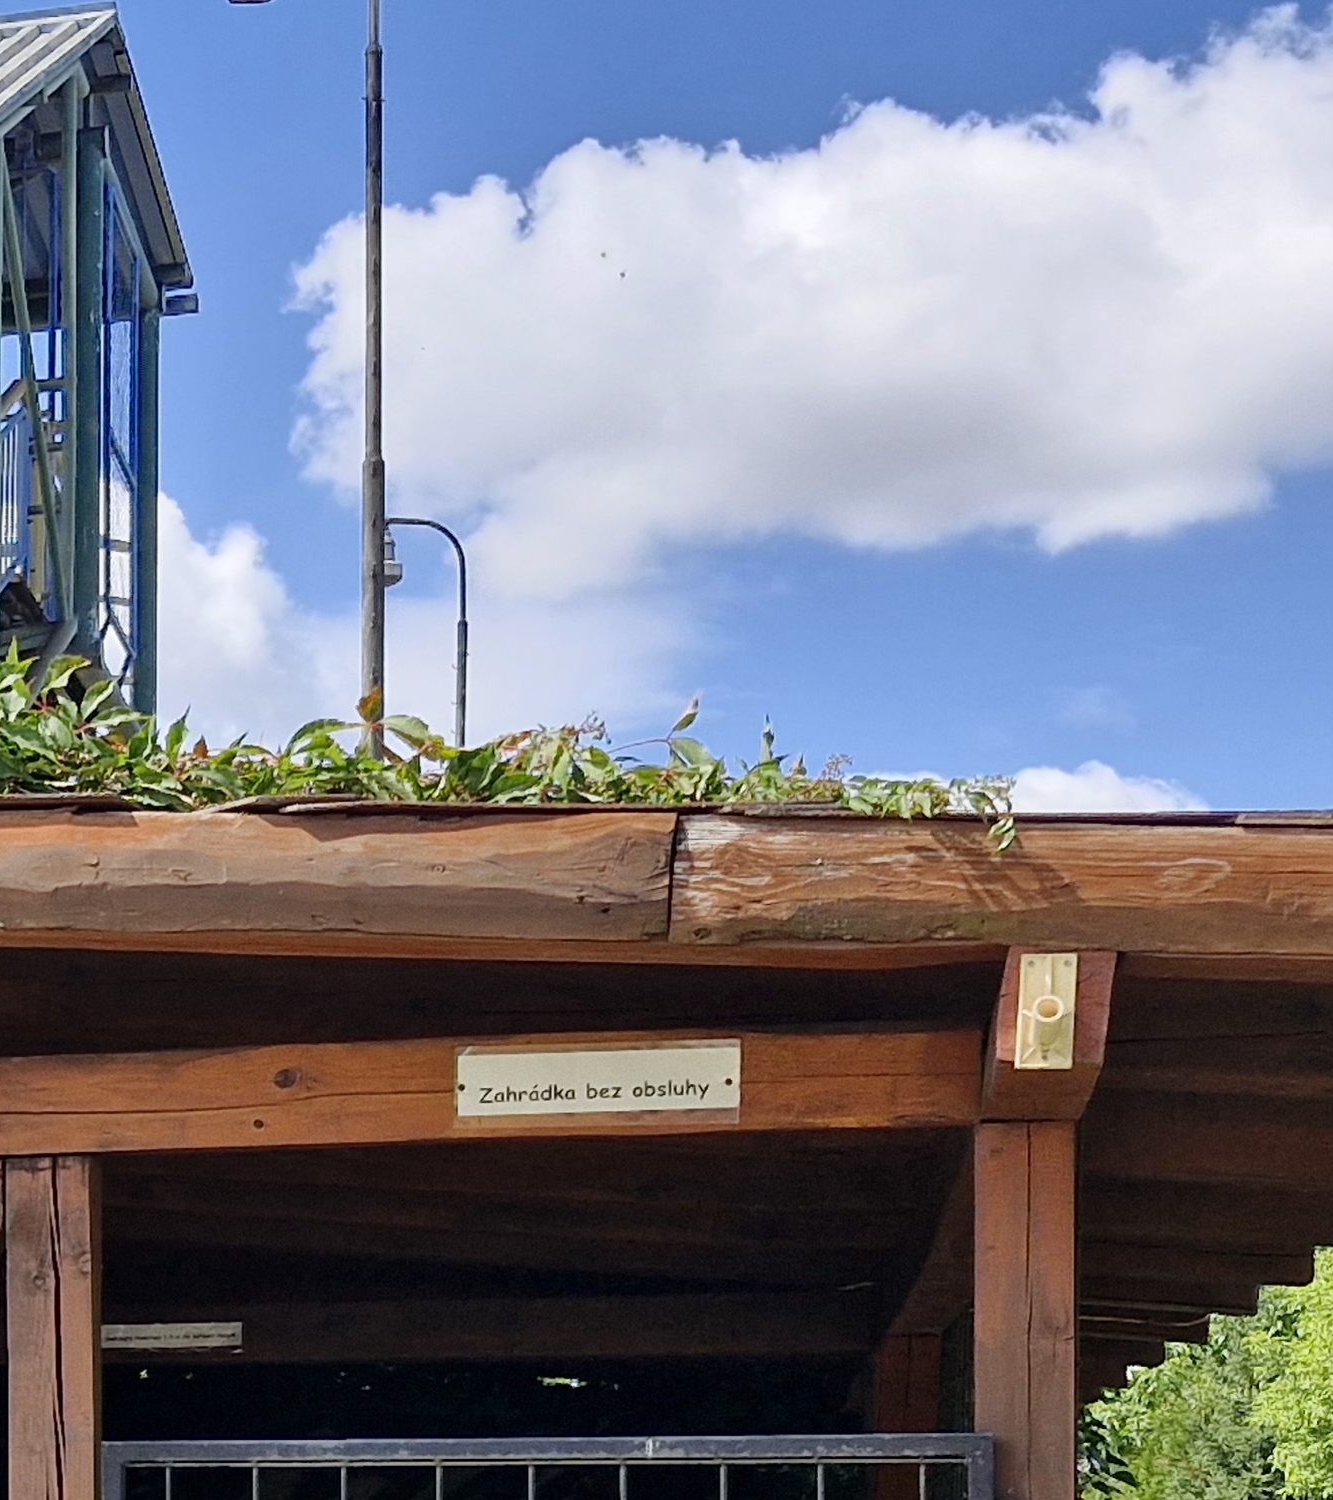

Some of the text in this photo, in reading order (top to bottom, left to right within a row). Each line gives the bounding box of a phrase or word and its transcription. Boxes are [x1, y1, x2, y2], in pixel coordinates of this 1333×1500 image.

[479, 1079, 710, 1104] Zahrádka bez obsluhy
